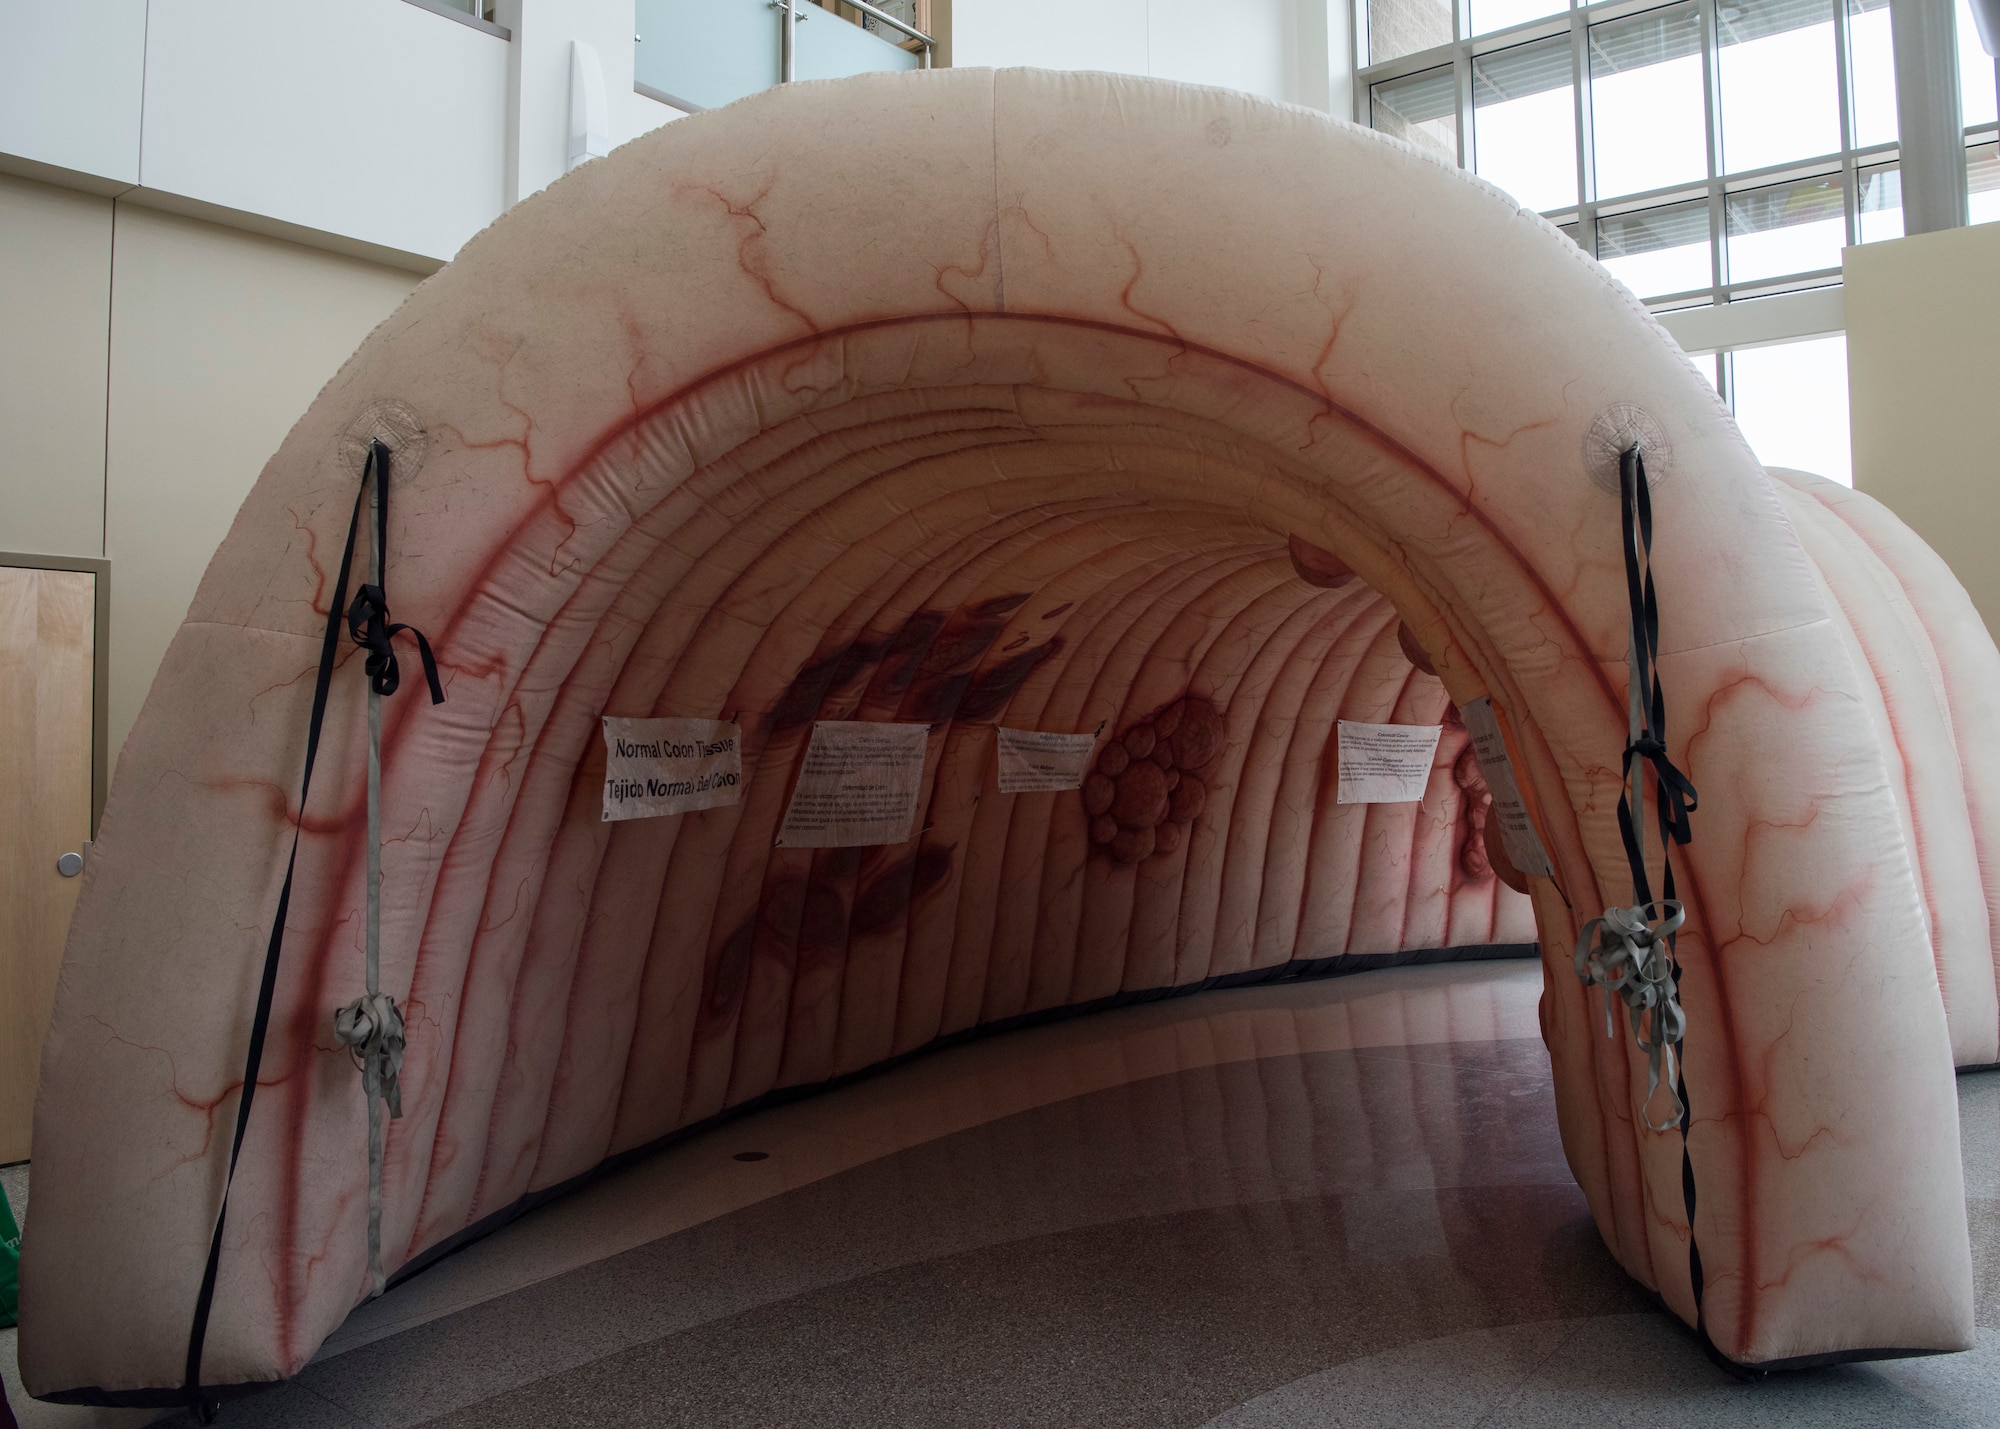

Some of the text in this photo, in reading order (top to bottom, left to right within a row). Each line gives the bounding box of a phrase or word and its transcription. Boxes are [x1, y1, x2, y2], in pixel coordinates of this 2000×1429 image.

[615, 738, 734, 758] Normal Colon Tissue
[607, 771, 741, 803] Tejido Normal del Colon
